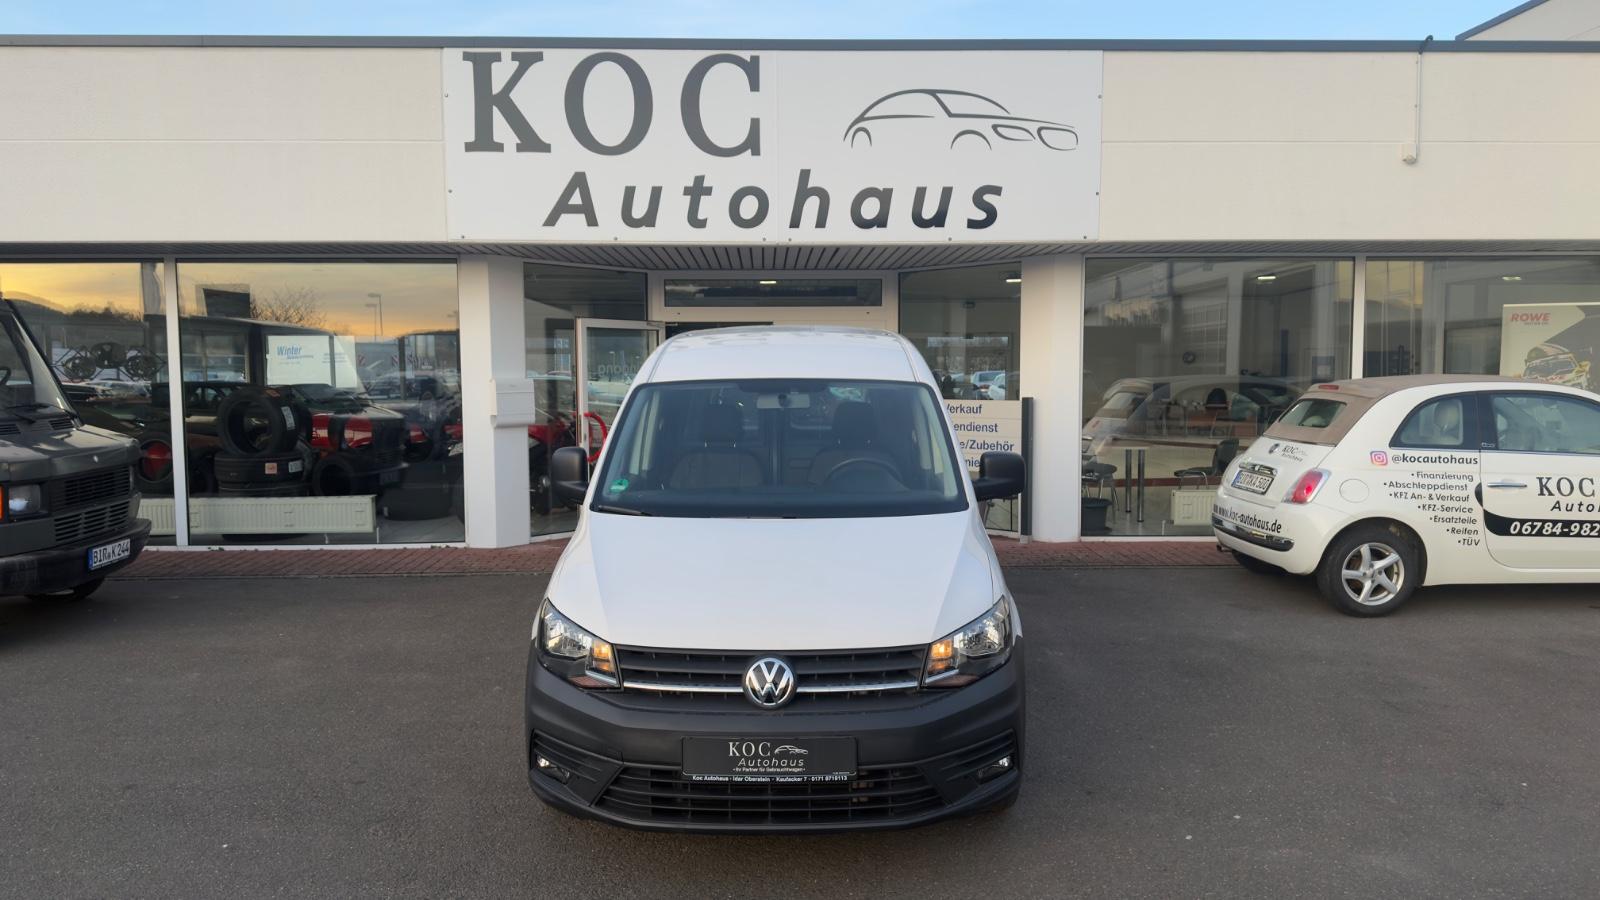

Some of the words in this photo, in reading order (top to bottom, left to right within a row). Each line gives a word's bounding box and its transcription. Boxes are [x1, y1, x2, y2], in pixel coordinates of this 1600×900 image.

[463, 51, 761, 157] KOC
[543, 169, 1003, 230] Autohaus
[1511, 312, 1552, 322] ROWE
[953, 422, 998, 433] endienst
[960, 440, 1015, 452] e/Zubehör
[1391, 453, 1479, 465] @kocautohaus
[1416, 471, 1474, 482] Finanzierung
[1388, 481, 1468, 491] Abschleppdienst
[1536, 476, 1596, 497] KOC
[1394, 491, 1408, 500] KFZ
[1436, 493, 1470, 502] Verkauf
[1422, 503, 1473, 513] KFZ-Service
[1550, 500, 1600, 513] Auto
[1434, 515, 1477, 525] Ersatzteile
[1451, 527, 1479, 535] Reifen
[1509, 521, 1600, 536] 06784-982
[1462, 536, 1480, 546] TÜV
[93, 547, 108, 564] BIR
[728, 741, 771, 757] KOC
[737, 757, 804, 767] Autohaus
